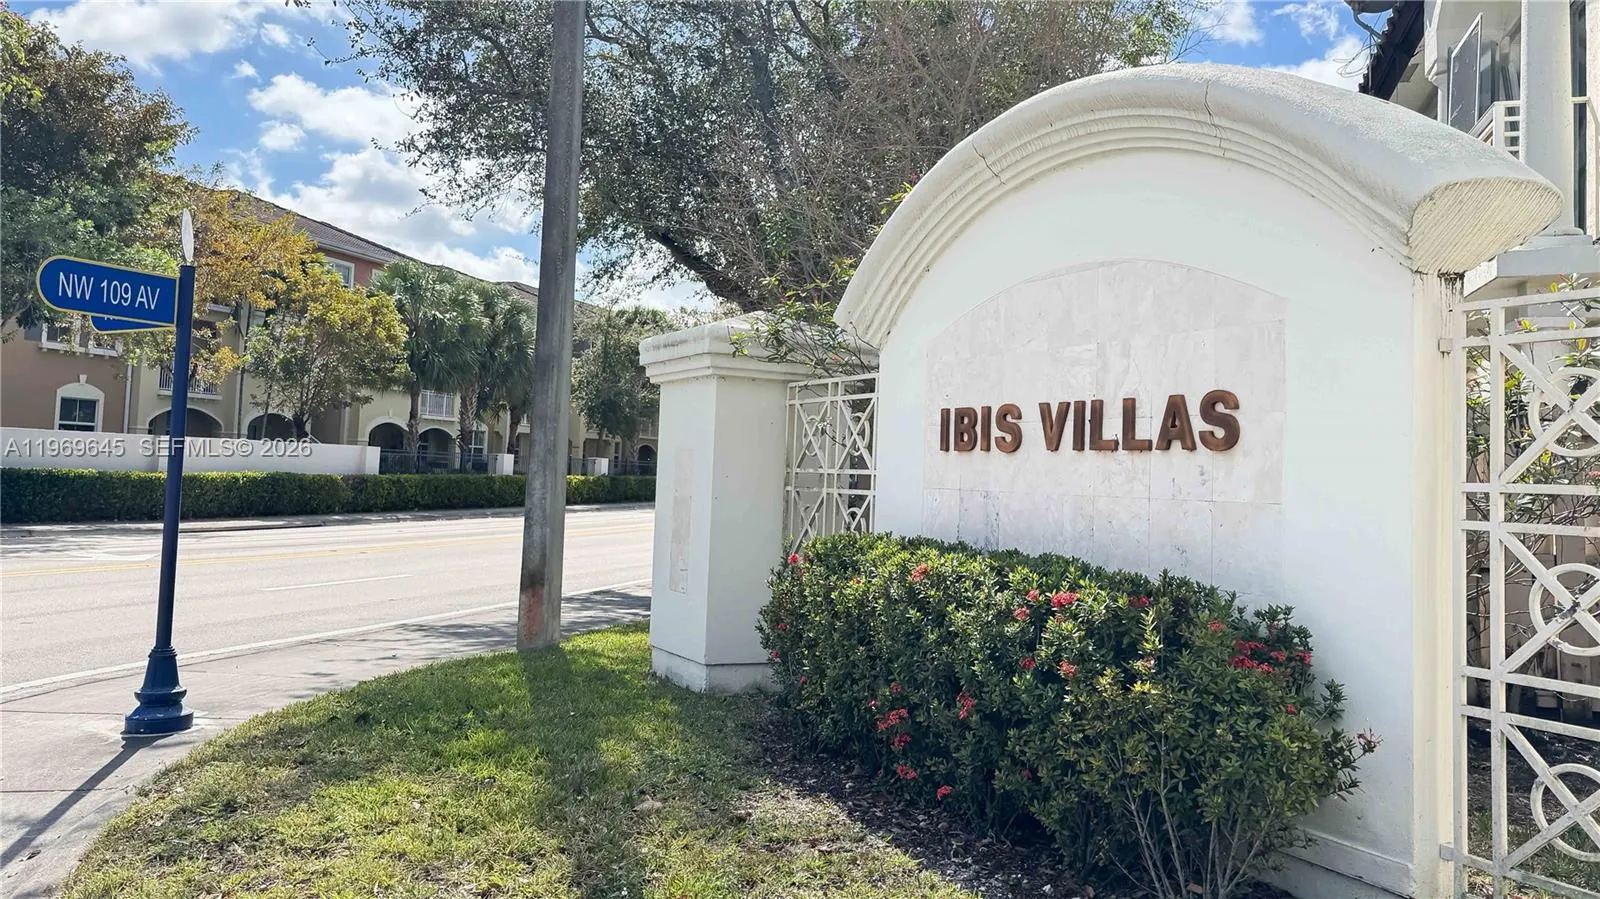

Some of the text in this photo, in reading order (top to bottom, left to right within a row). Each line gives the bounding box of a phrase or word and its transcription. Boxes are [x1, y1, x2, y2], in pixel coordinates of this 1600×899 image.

[58, 271, 160, 310] NW 109 AV
[939, 389, 1241, 453] IBIS VILLAS
